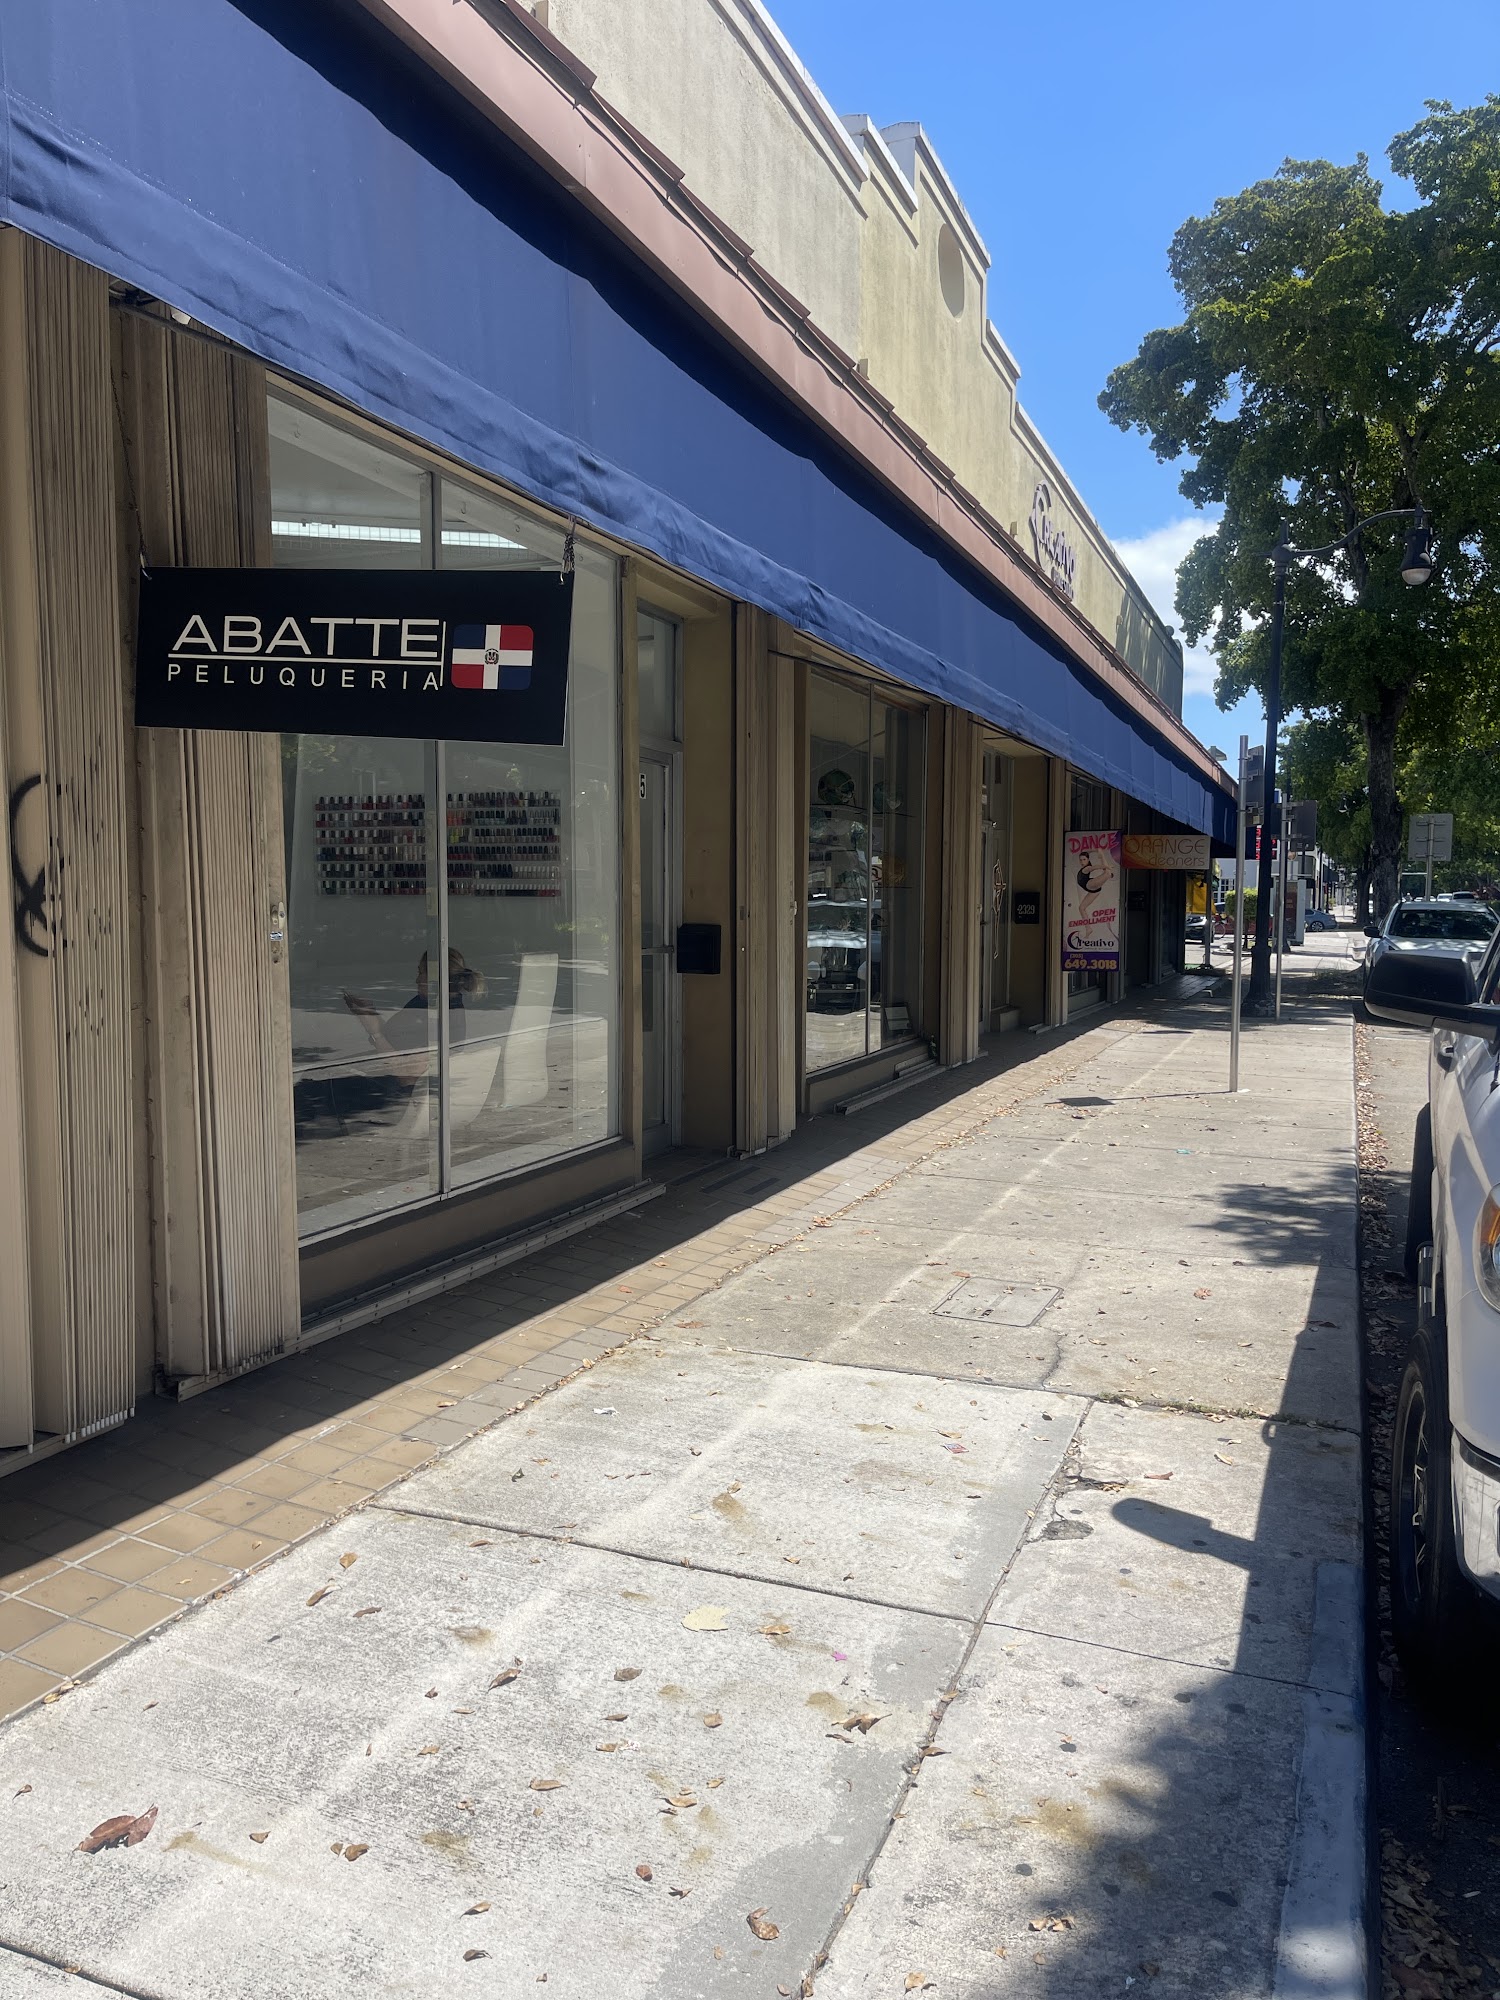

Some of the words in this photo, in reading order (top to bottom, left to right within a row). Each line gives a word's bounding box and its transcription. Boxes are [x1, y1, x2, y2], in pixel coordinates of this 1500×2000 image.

[172, 613, 440, 659] ABATTE
[167, 663, 439, 691] PELUQUERIA
[1068, 832, 1119, 855] DANCE
[1125, 838, 1206, 855] ORANGE
[1149, 854, 1205, 867] cleaners
[1069, 915, 1116, 928] ENROLLMENT
[1092, 908, 1116, 918] OPEN
[1067, 930, 1115, 951] Creativo
[1064, 958, 1117, 970] 649.3018
